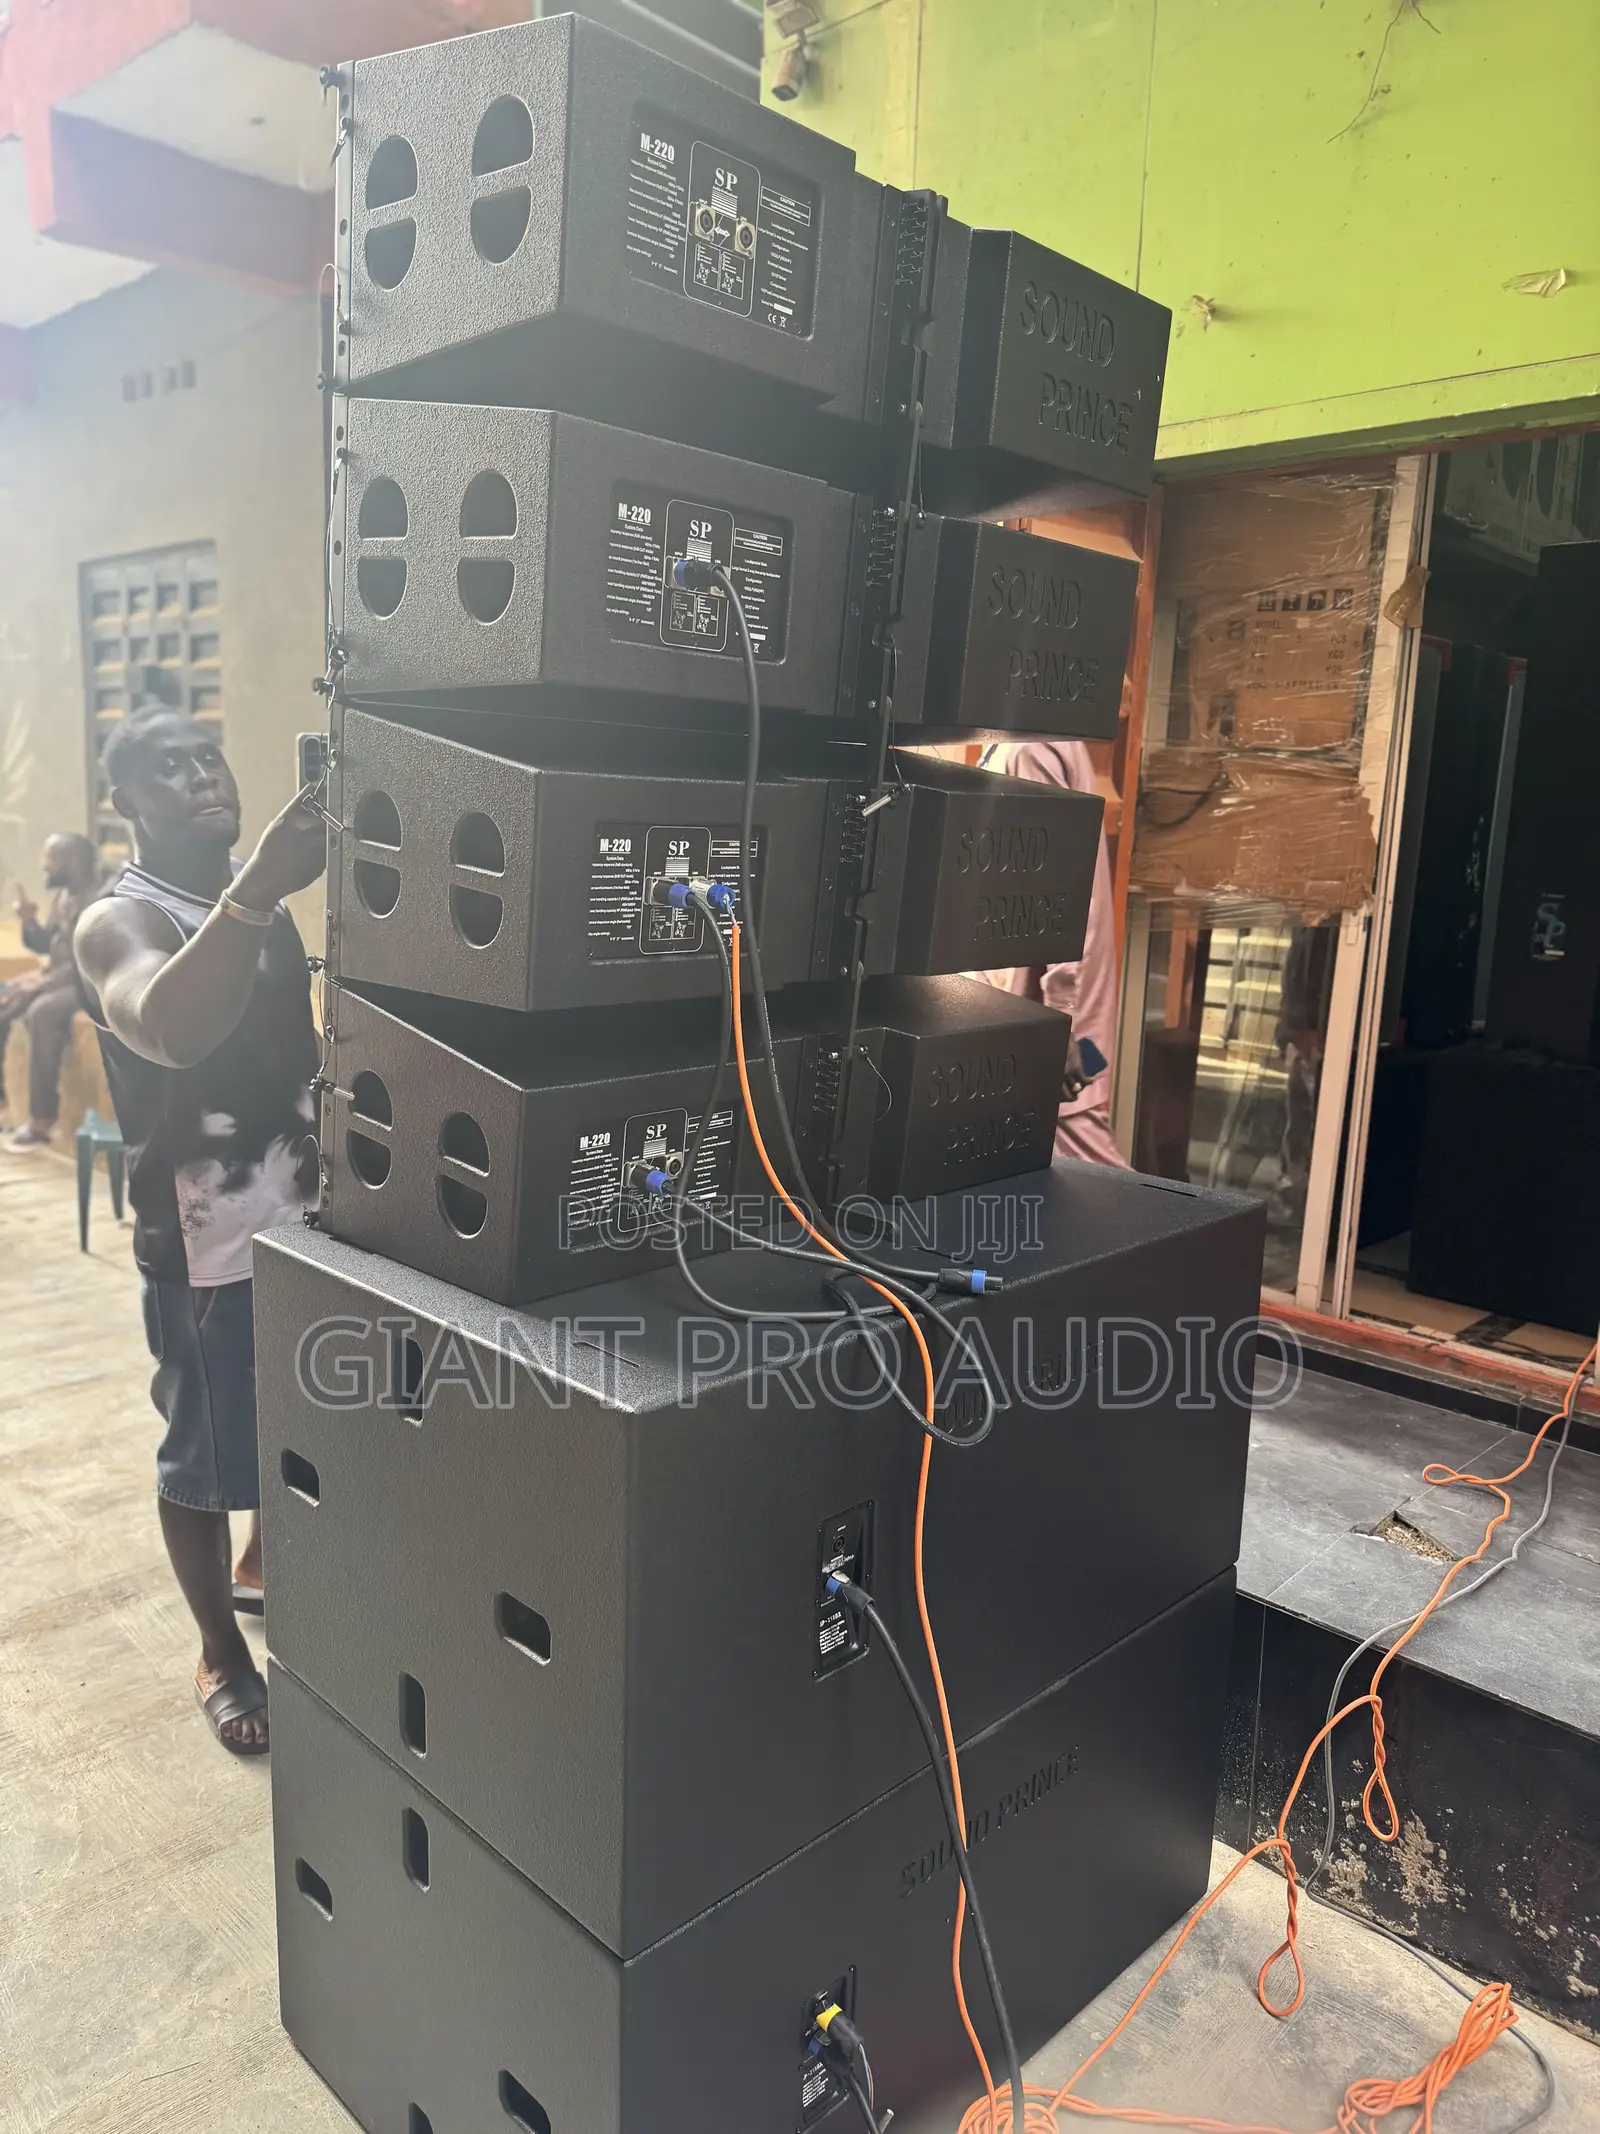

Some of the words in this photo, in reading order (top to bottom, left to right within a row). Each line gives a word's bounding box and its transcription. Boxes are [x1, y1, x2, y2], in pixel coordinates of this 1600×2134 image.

[640, 133, 675, 161] M-220
[715, 168, 738, 191] SP
[1019, 280, 1115, 367] SOUND
[1038, 372, 1133, 454] PRINCE
[618, 503, 651, 523] M-220
[690, 520, 712, 538] SP
[987, 565, 1081, 629] SOUND
[1005, 646, 1099, 704] PRINCE
[600, 838, 631, 852] M-220
[668, 841, 690, 855] SP
[956, 827, 1049, 873] SOUND
[973, 892, 1068, 940] PRINCE
[928, 1054, 1016, 1107] SOUND
[580, 1132, 611, 1149] M-220
[646, 1123, 667, 1139] SP
[996, 1743, 1082, 1831] PRINCE
